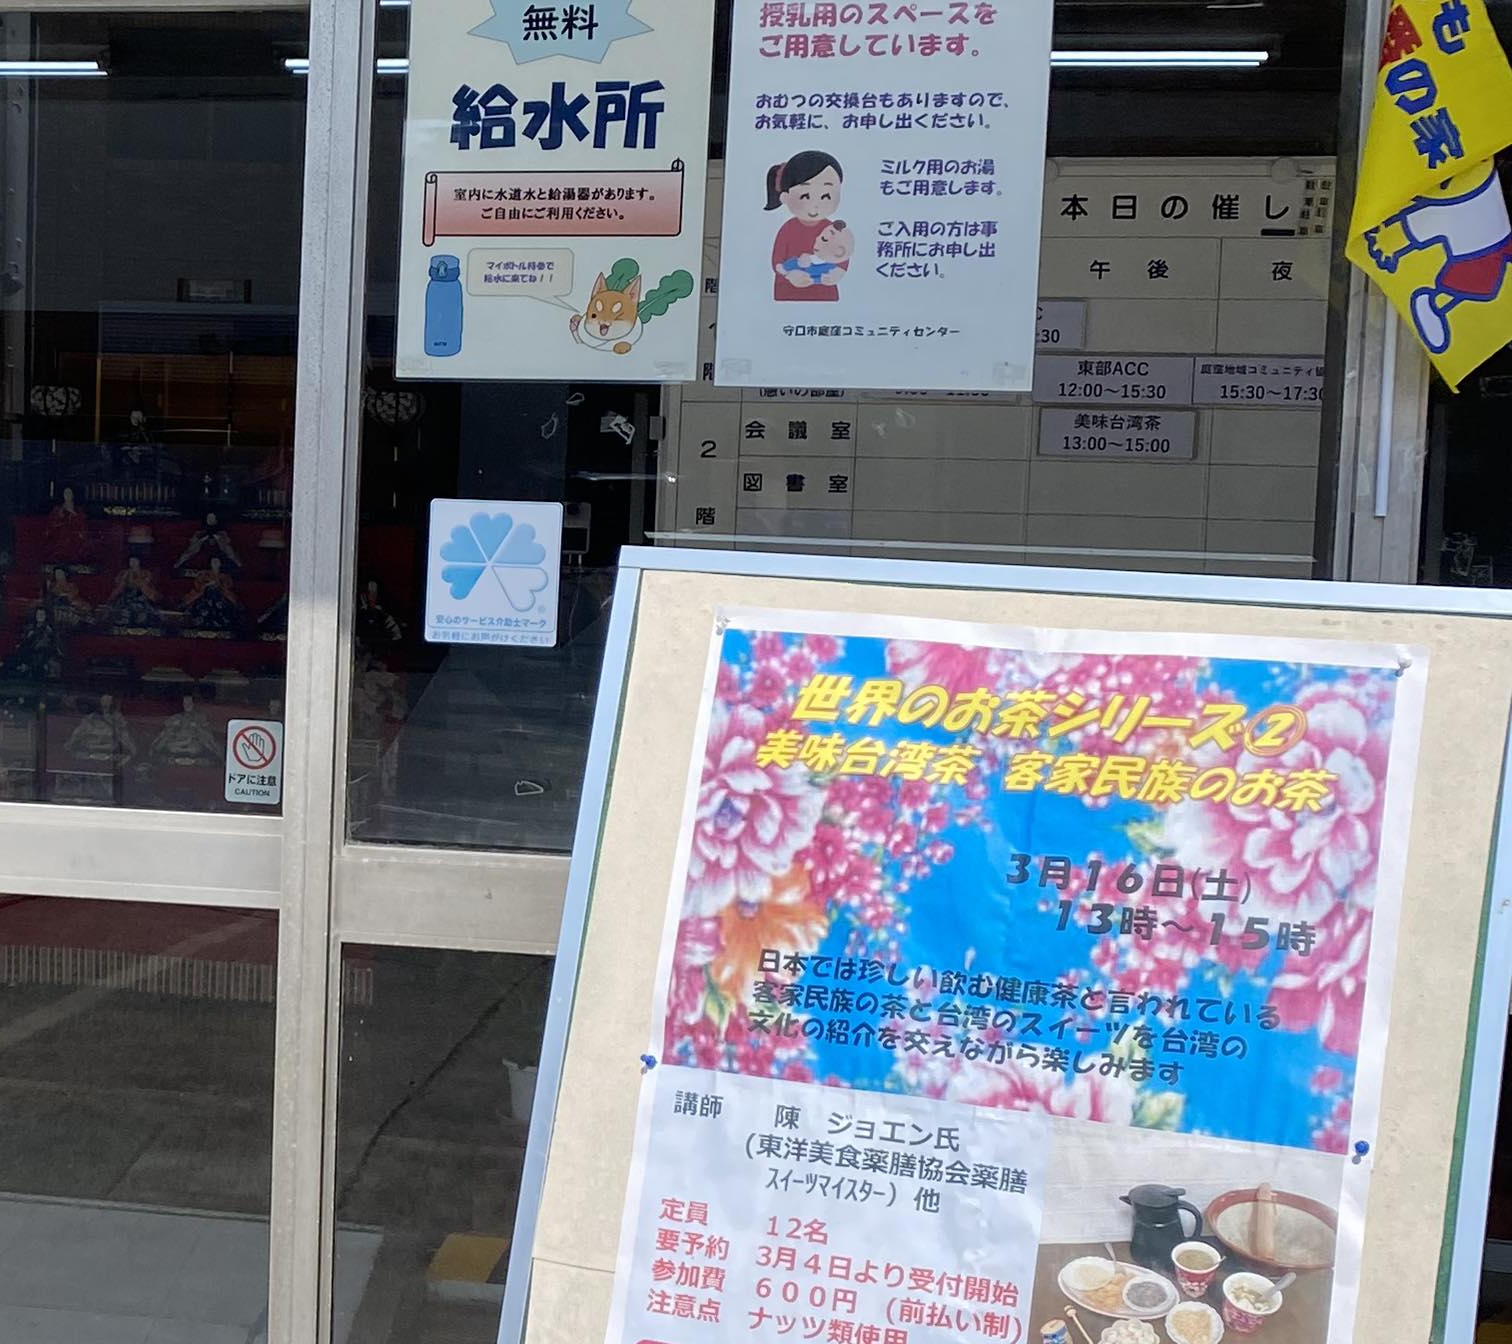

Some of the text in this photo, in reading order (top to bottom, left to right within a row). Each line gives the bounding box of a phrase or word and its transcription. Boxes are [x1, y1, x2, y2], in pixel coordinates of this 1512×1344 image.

[521, 3, 599, 41] 無料
[759, 1, 999, 28] 授乳用のスペースを
[759, 32, 982, 59] ご用意しています。
[754, 92, 1010, 110] おむつの交換台もありますので、
[449, 79, 666, 150] 給水所
[754, 113, 992, 131] お気軽に、お申し出ください。
[879, 159, 996, 176] ミルク用のお湯
[453, 187, 656, 201] 室内に水道水と給湯器があります。
[879, 179, 1004, 197] もご用意します。
[480, 206, 625, 220] ご自由にご利用ください。
[876, 220, 999, 238] ご入用の方は事
[875, 240, 997, 258] 務所にお申し出
[874, 261, 946, 279] ください。
[1089, 259, 1293, 281] 午後 夜
[782, 324, 961, 339] 守口市庭窪コミュニティセンター
[1076, 359, 1150, 377] 東部ACC
[1057, 382, 1167, 399] 12:00～15:30
[744, 420, 852, 441] 会議室
[1073, 413, 1162, 431] 美味台湾茶
[1062, 435, 1171, 453] 13:00～15:00
[742, 472, 850, 494] 図書室
[227, 772, 277, 787] ドアに注意
[755, 727, 1339, 813] 美味台湾茶 客家民族のお茶
[234, 787, 270, 797] CAUTION
[756, 948, 1281, 1031] 日本では珍しい飲む健康茶と言われている
[751, 979, 1250, 1060] 客家民族の茶と台湾のスイーツを台湾の
[746, 1009, 1185, 1086] 文化の紹介を交えながら楽しみます
[672, 1089, 961, 1153] 講師 陳 ジョエン氏
[658, 1197, 829, 1246] 定員 12名
[655, 1227, 730, 1261] 要予約
[651, 1257, 727, 1293] 参加費
[646, 1287, 723, 1324] 注意点
